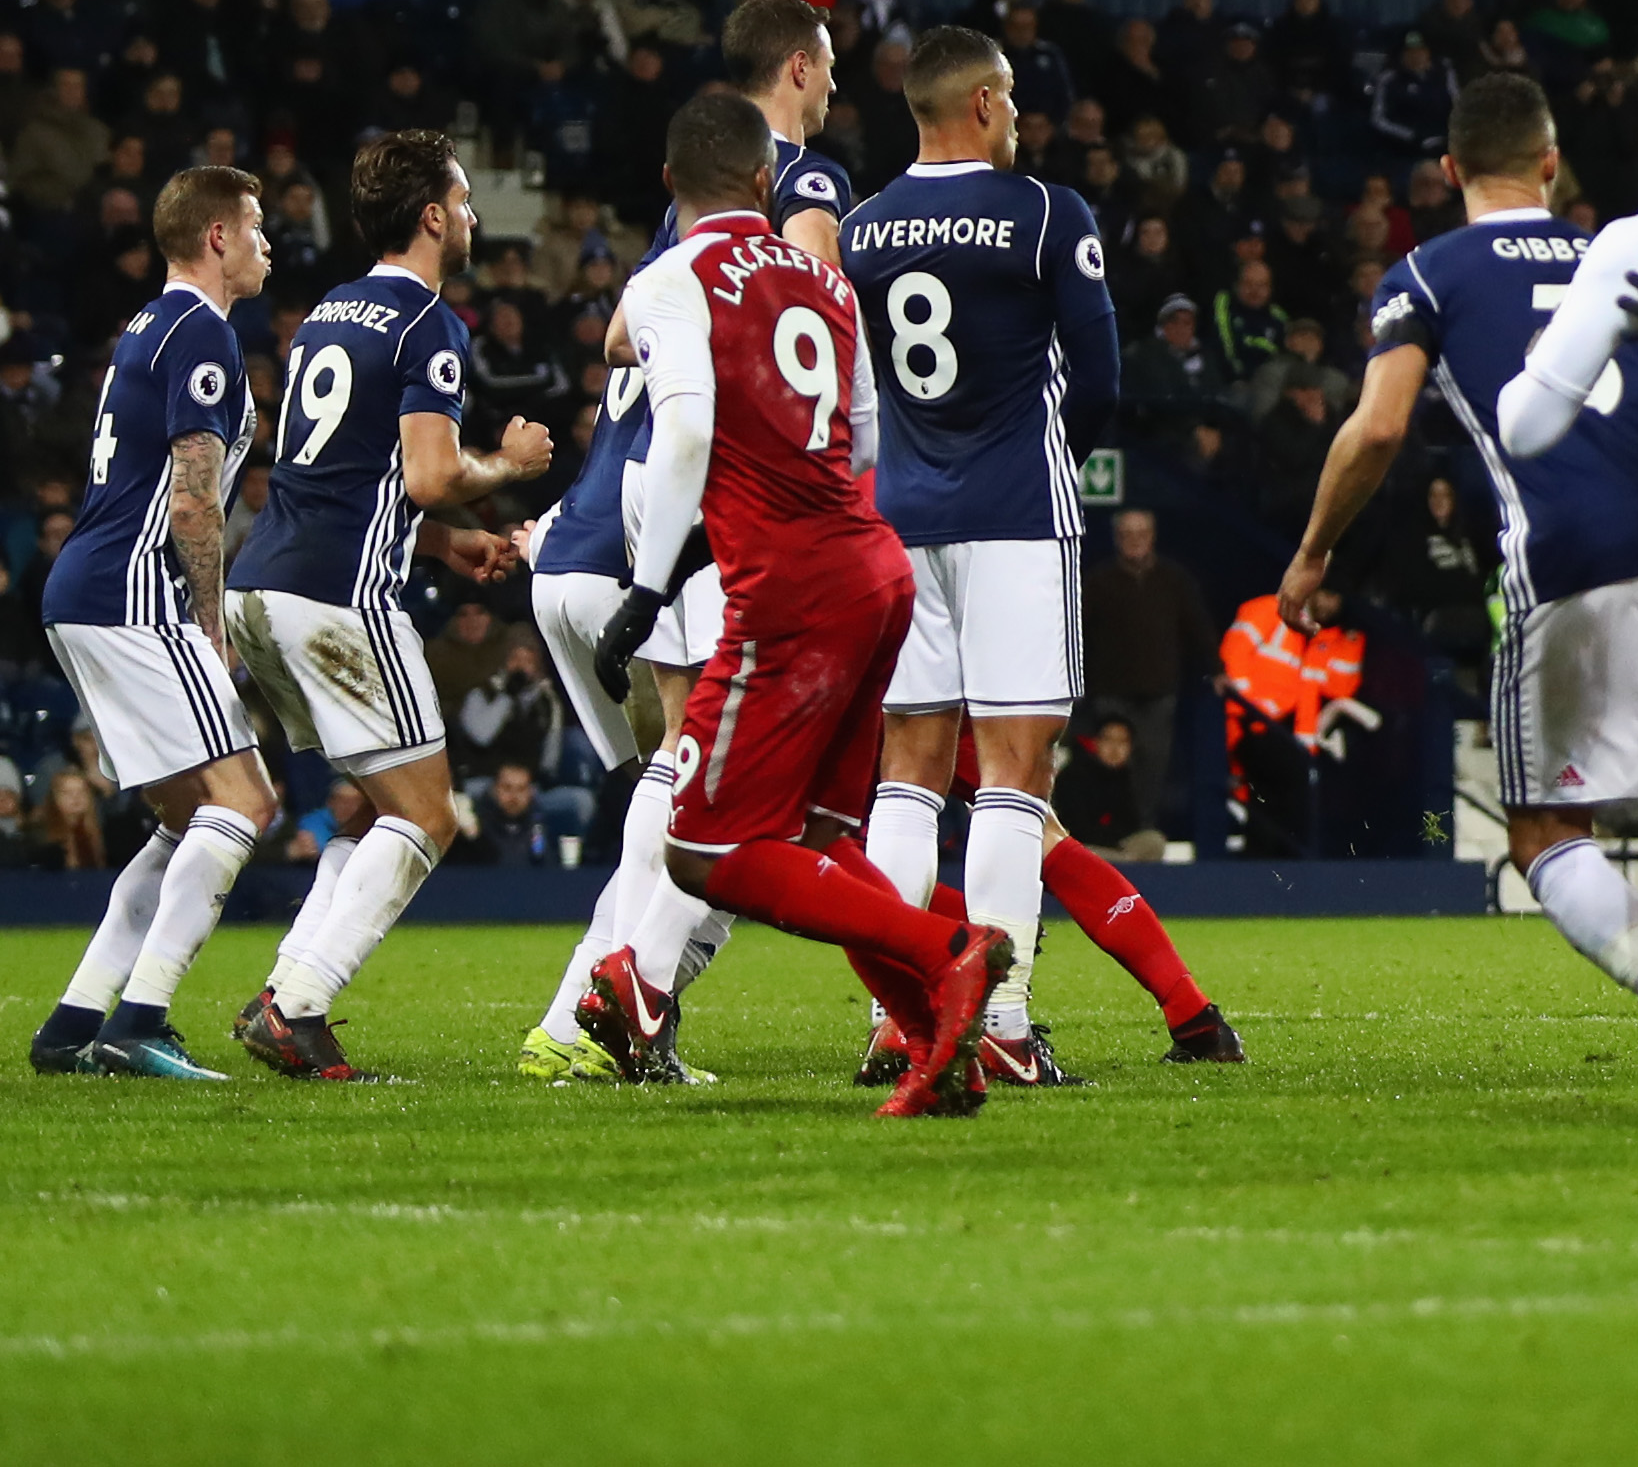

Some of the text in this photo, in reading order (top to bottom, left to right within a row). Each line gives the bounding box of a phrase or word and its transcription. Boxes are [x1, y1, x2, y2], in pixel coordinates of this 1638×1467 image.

[713, 244, 850, 306] LACAZETTE
[851, 217, 1014, 251] LIVERMORE
[773, 306, 839, 451] 9
[887, 271, 958, 400] 8
[276, 344, 353, 466] 19
[672, 734, 701, 796] 9
